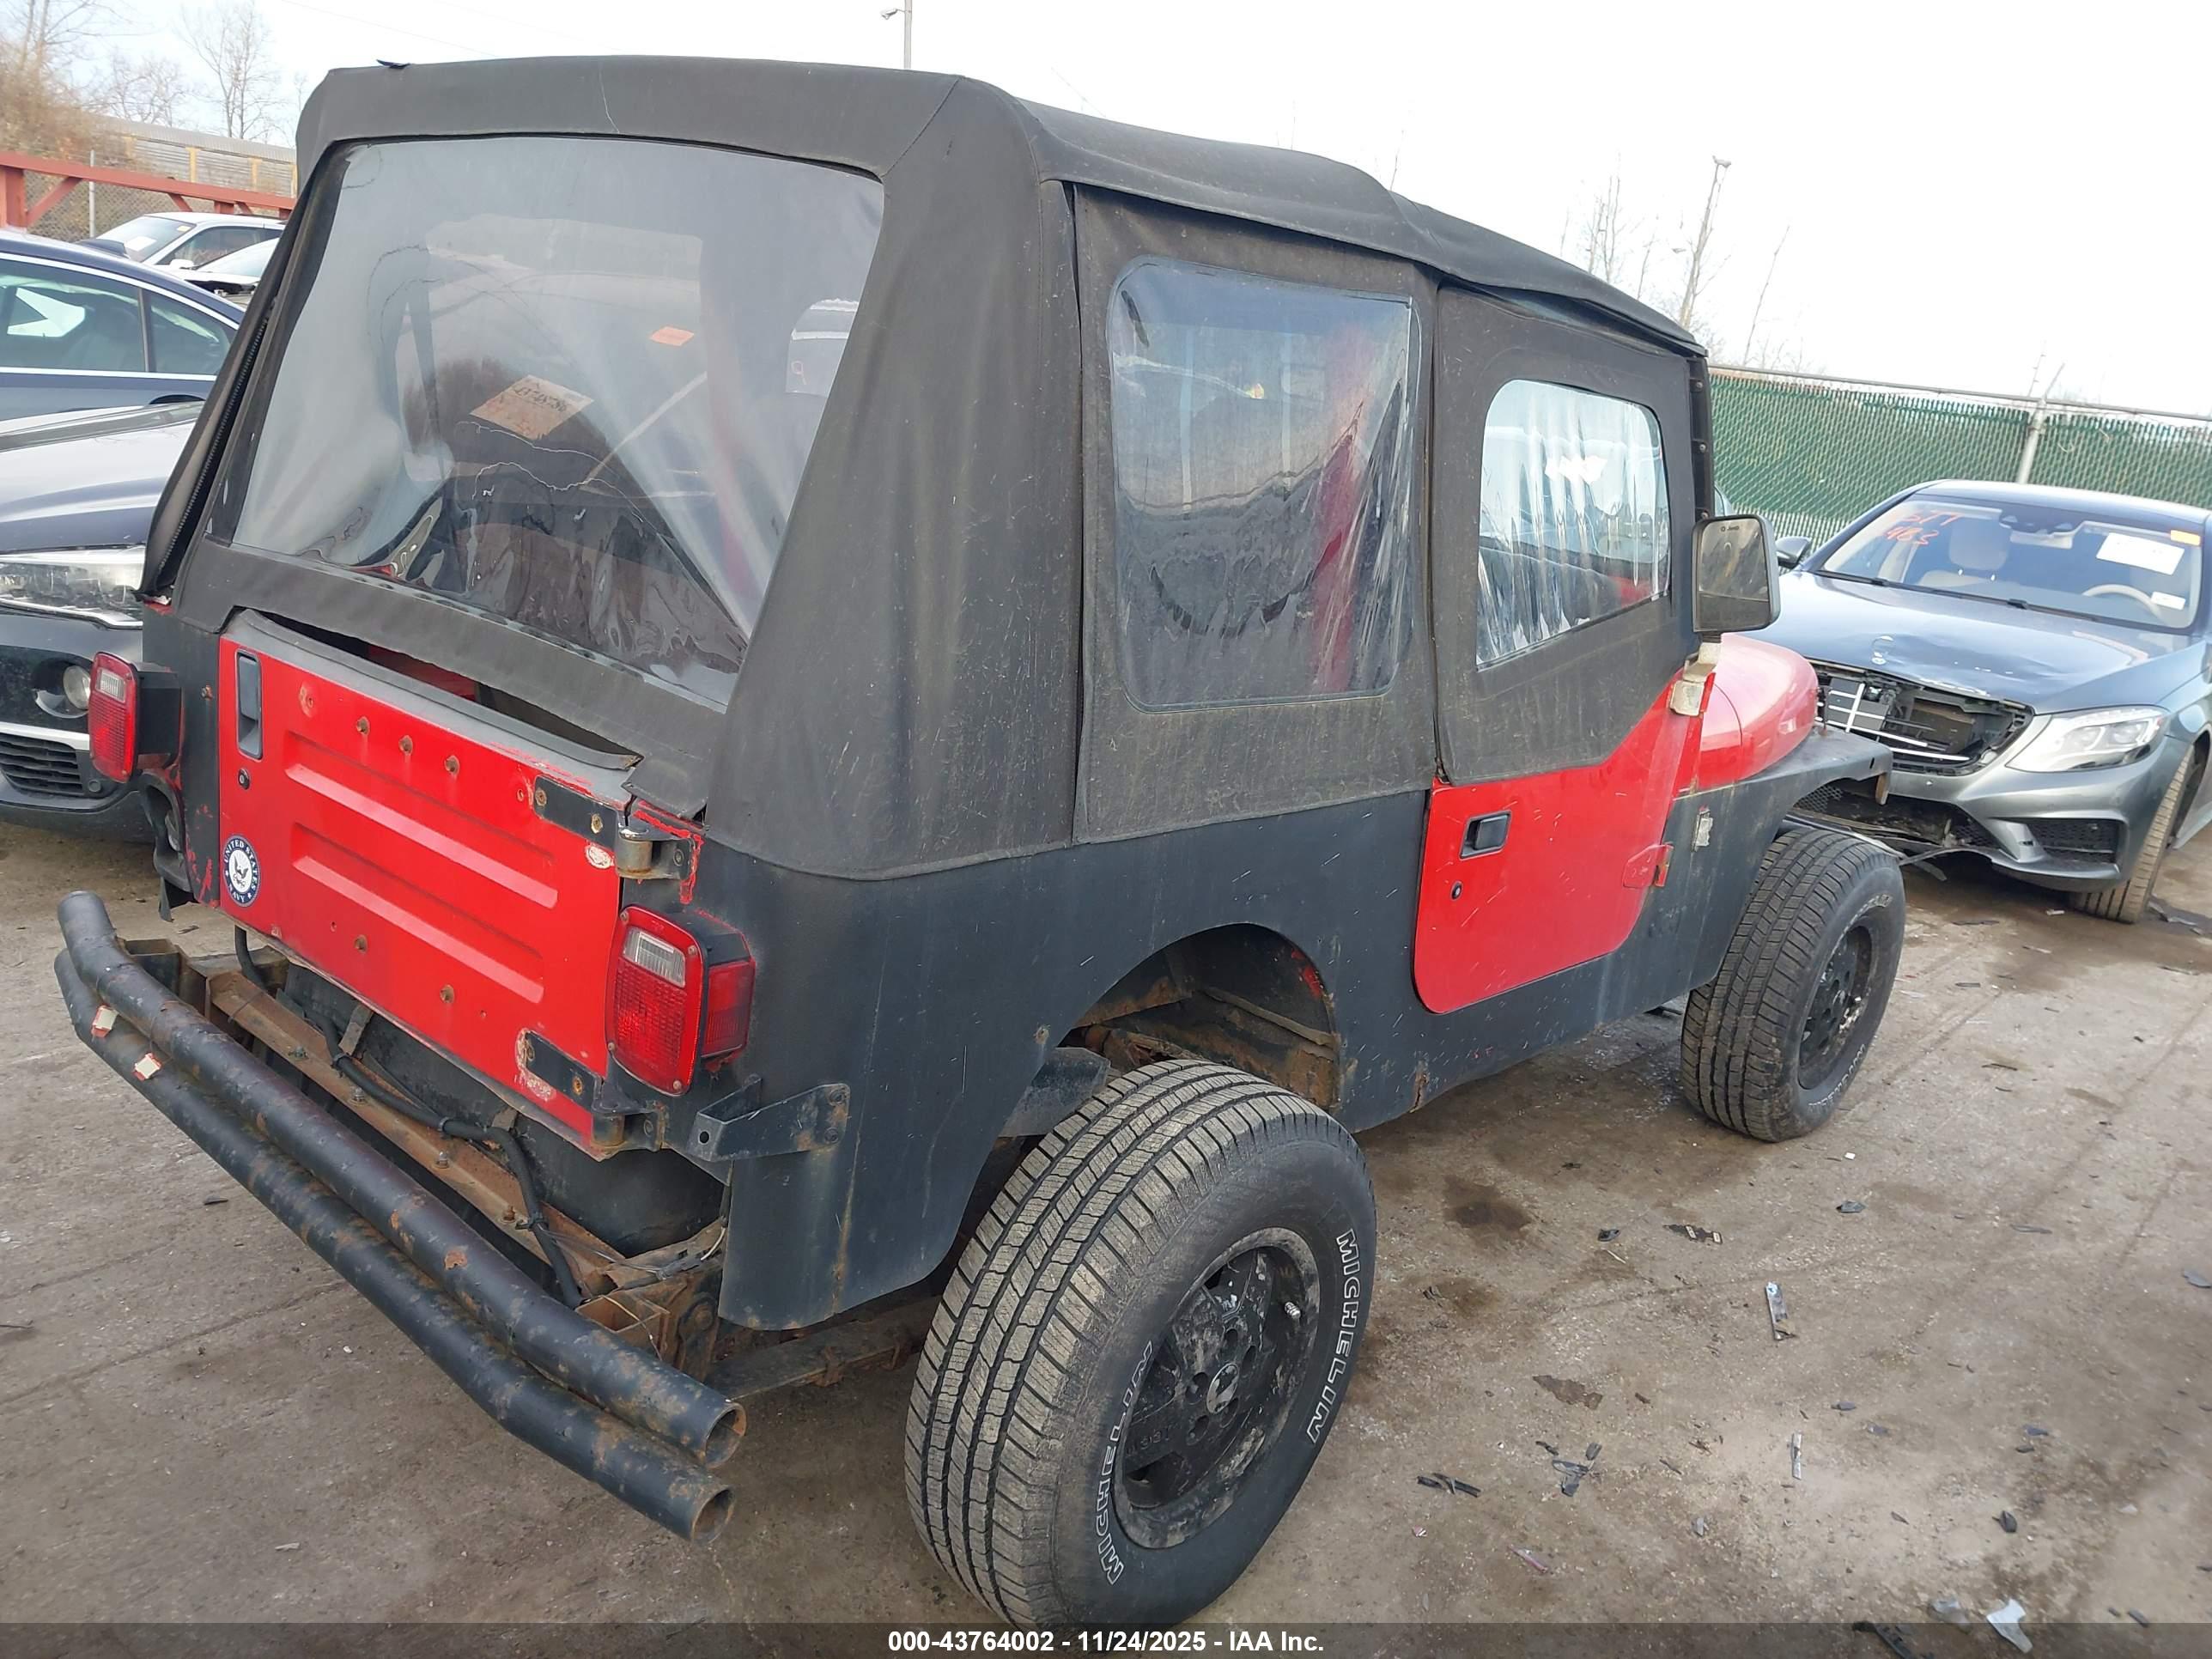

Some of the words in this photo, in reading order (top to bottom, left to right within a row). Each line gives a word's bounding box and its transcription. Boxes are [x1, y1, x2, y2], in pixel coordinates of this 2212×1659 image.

[224, 839, 245, 863] UNITED
[245, 847, 258, 890] STATES
[228, 883, 246, 903] NAVY
[1307, 1228, 1361, 1443] MICHELIN
[1096, 1340, 1153, 1585] MICHELIN
